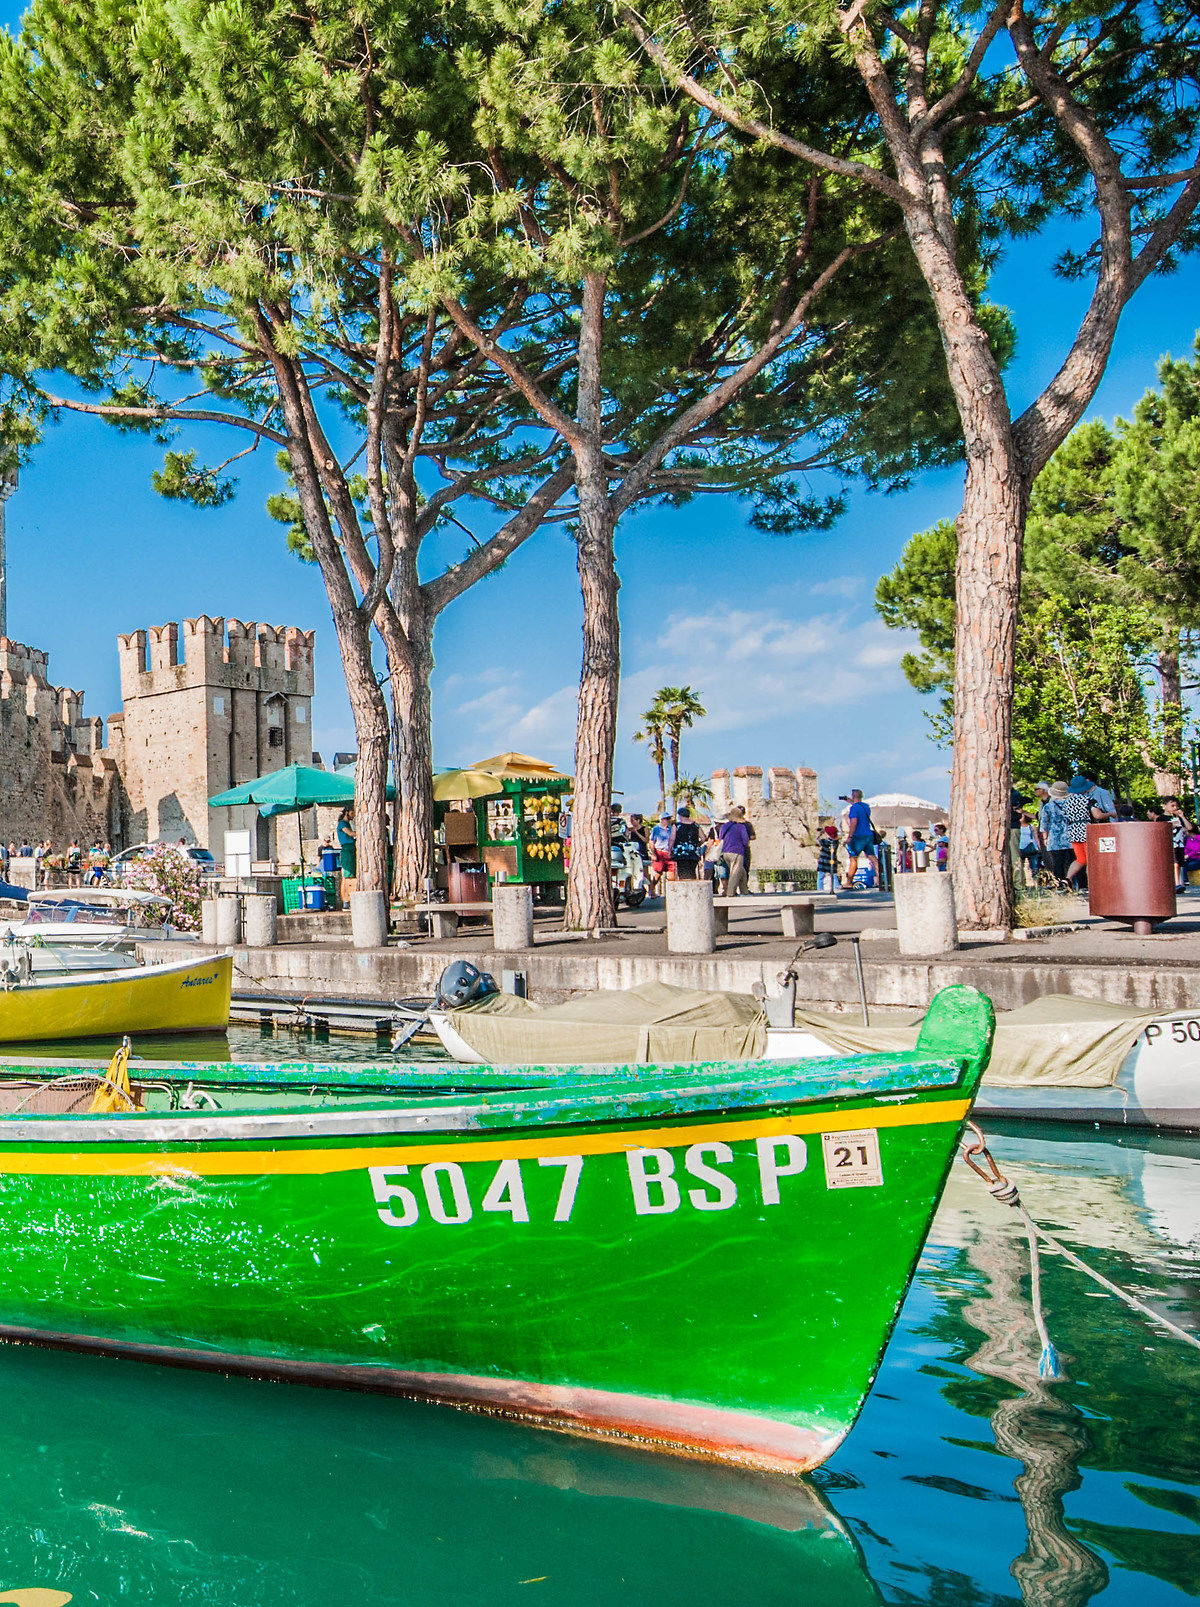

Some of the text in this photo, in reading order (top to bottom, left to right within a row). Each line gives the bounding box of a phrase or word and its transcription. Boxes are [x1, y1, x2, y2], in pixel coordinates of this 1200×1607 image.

[1144, 1023, 1162, 1046] P
[833, 1146, 868, 1167] 21
[368, 1155, 584, 1227] 5047
